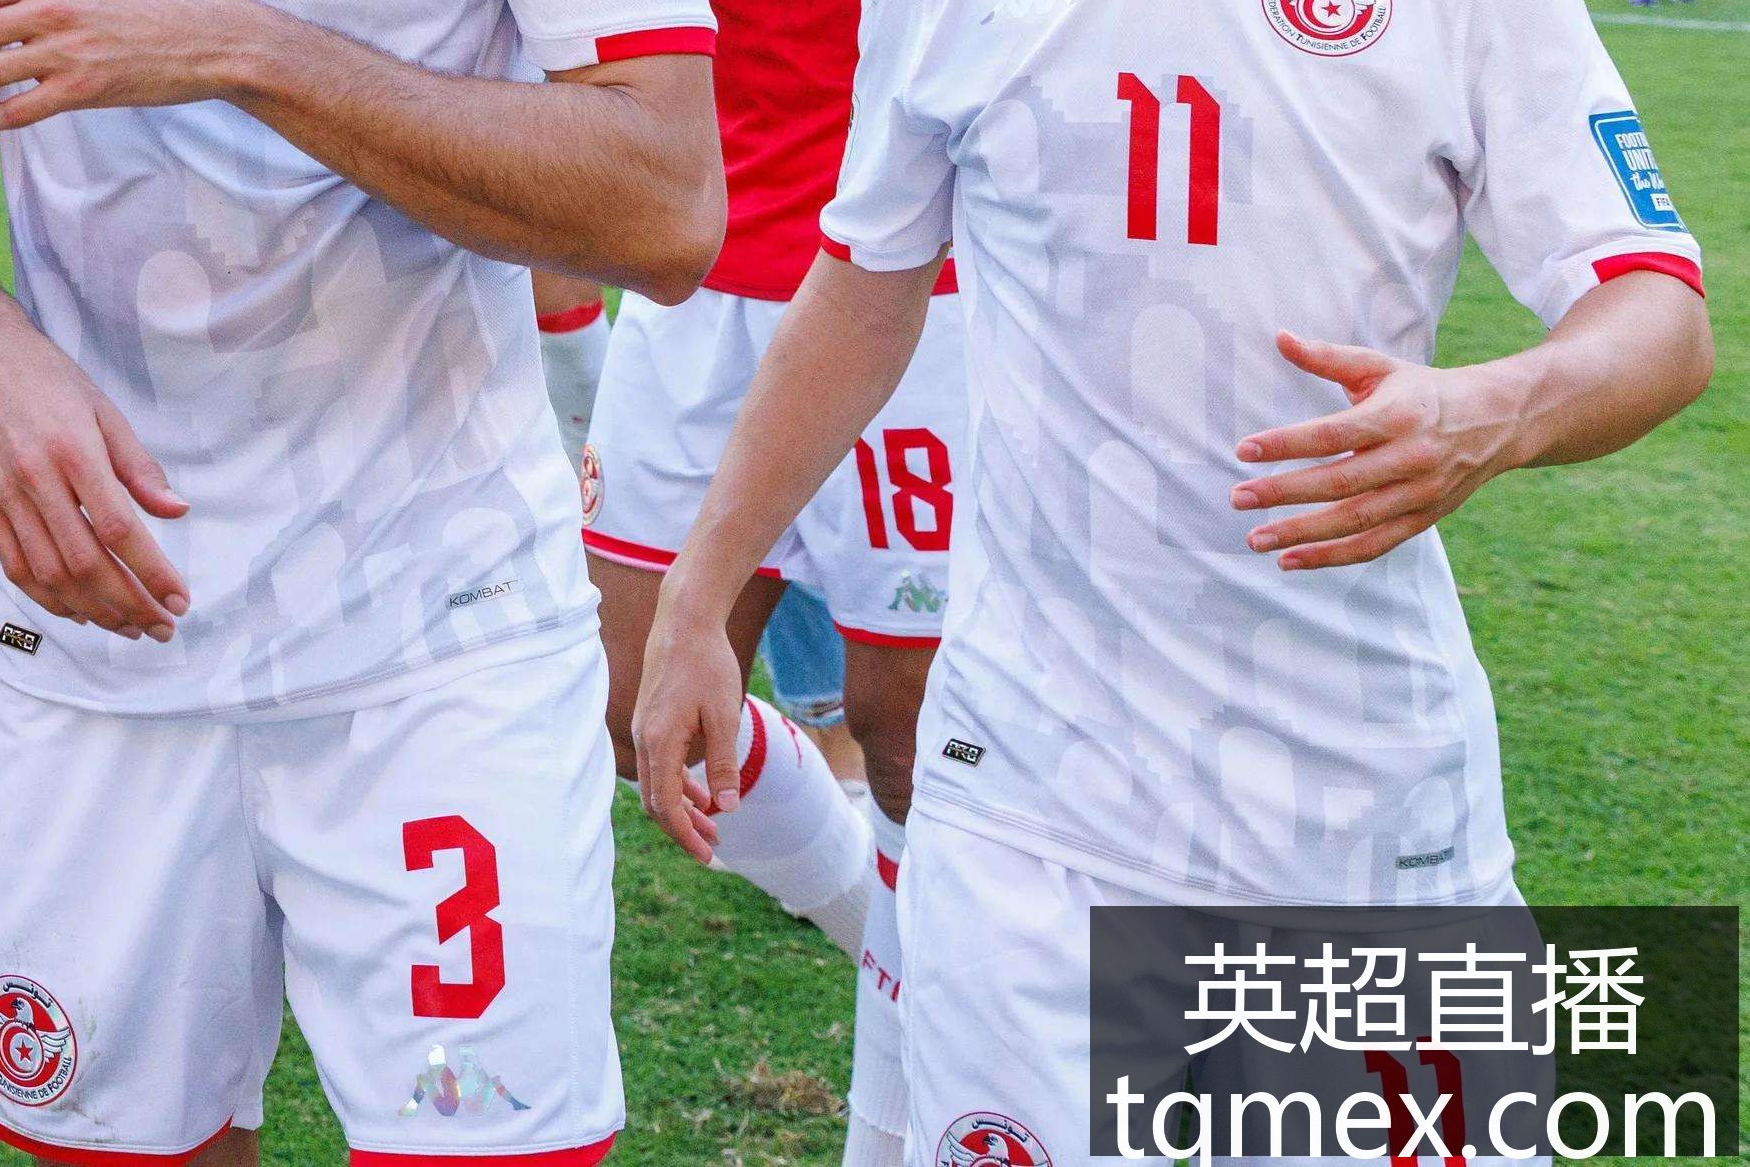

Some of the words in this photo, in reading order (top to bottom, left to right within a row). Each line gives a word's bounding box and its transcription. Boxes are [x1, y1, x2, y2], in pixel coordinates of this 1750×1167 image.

[1117, 72, 1220, 246] 11
[853, 428, 954, 551] 18
[449, 580, 515, 607] KOMBAT
[401, 815, 505, 1019] 3
